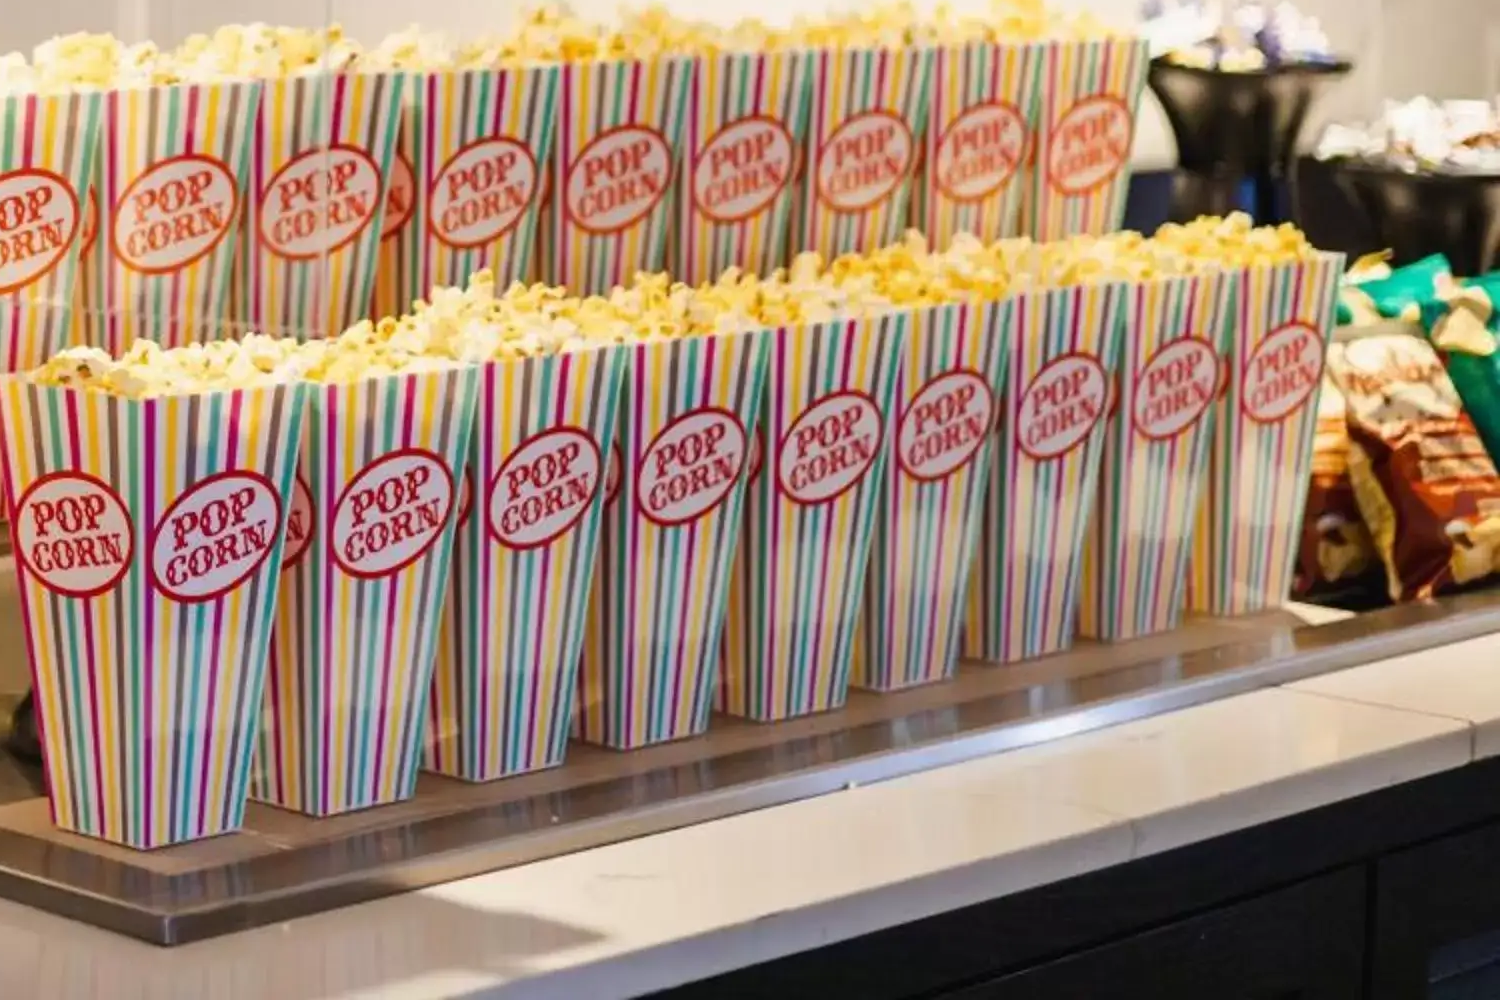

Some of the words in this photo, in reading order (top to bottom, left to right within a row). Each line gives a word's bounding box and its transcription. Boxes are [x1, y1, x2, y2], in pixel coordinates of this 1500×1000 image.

[582, 139, 650, 188] POP
[711, 129, 774, 177] POP
[829, 151, 902, 194] CORN
[835, 124, 894, 168] POP
[133, 170, 212, 225] POP
[447, 150, 517, 202] POP
[578, 167, 660, 220] CORN
[705, 157, 782, 206] CORN
[126, 201, 225, 258] CORN
[440, 180, 525, 234] CORN
[1148, 350, 1203, 396] POP
[1257, 333, 1309, 382] POP
[913, 383, 976, 436] POP
[1031, 366, 1090, 418] POP
[1143, 376, 1209, 425] CORN
[1252, 359, 1315, 410] CORN
[795, 405, 862, 460] POP
[908, 411, 983, 467] CORN
[1026, 393, 1097, 446] CORN
[505, 441, 580, 501] POP
[654, 422, 726, 480] POP
[790, 434, 871, 492] CORN
[350, 465, 430, 528] POP
[501, 473, 589, 535] CORN
[649, 453, 735, 512] CORN
[30, 493, 107, 537] POP
[171, 487, 256, 552] POP
[344, 498, 441, 563] CORN
[32, 533, 123, 573] CORN
[165, 520, 268, 587] CORN
